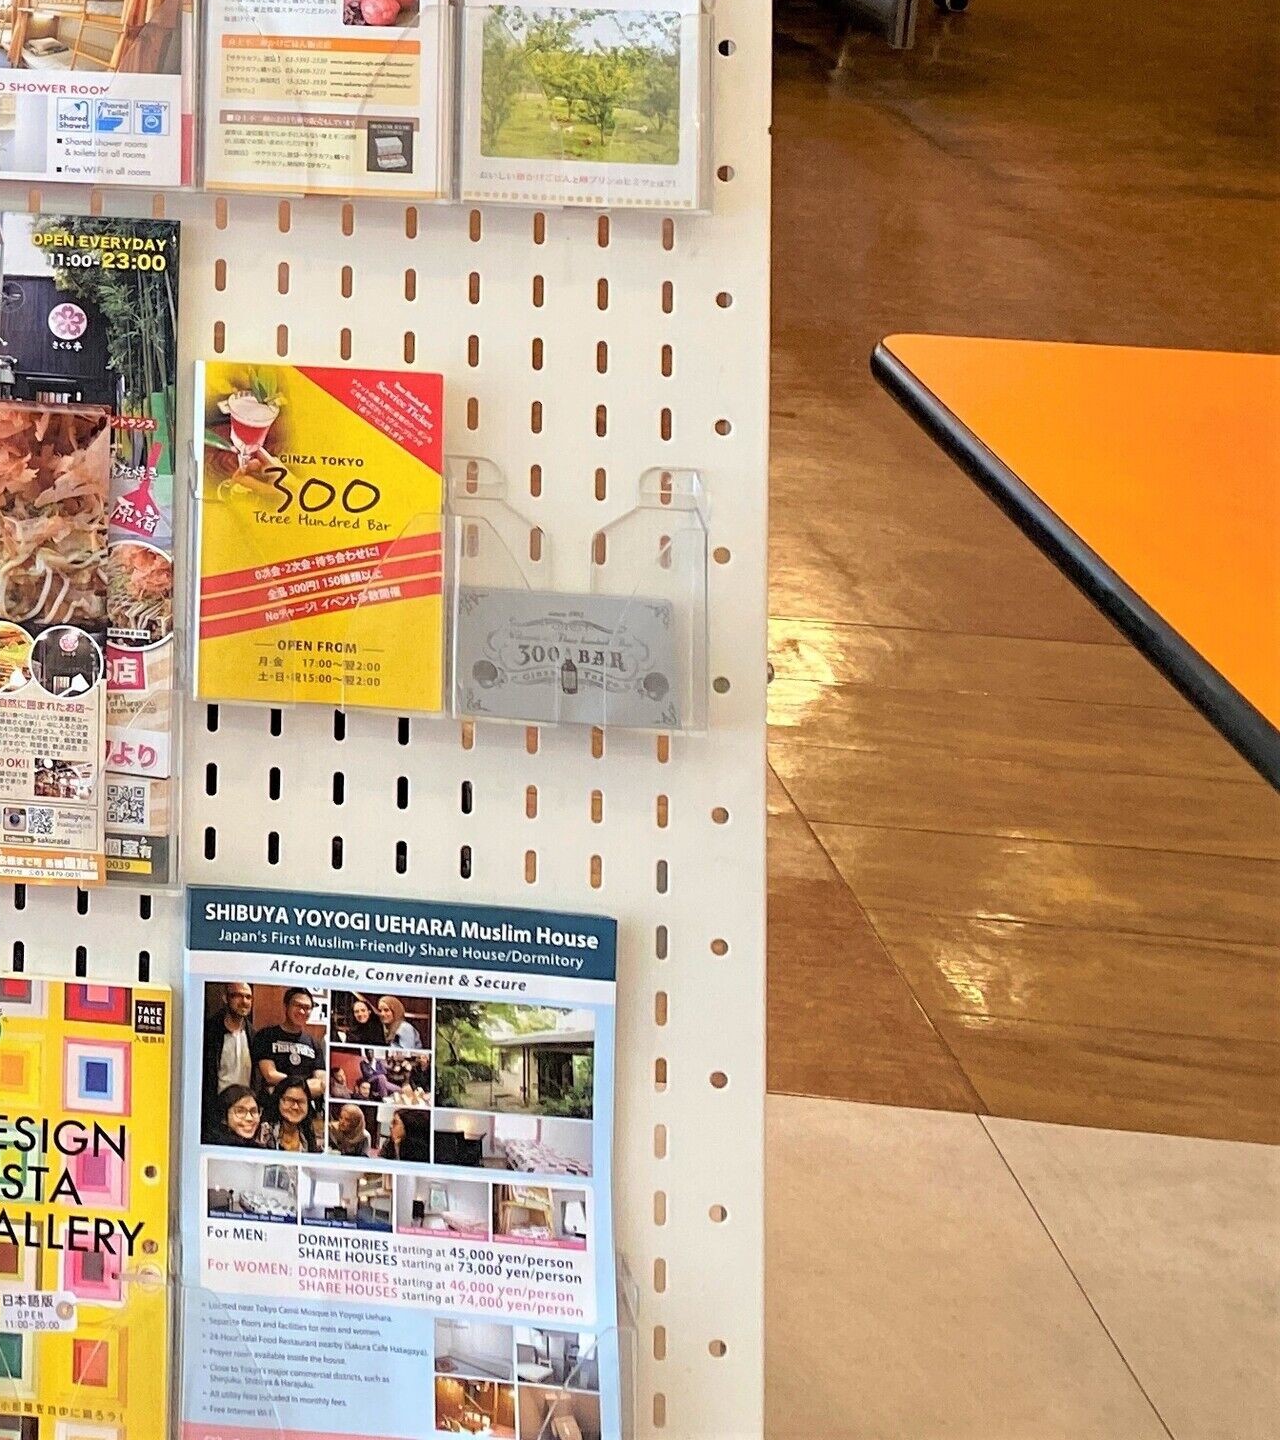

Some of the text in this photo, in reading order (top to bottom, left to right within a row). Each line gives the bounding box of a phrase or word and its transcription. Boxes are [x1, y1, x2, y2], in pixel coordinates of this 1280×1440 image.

[33, 233, 166, 252] OPEN EVERYDAY
[280, 455, 364, 467] GINZA TOKYO
[264, 467, 380, 513] 300
[254, 511, 391, 531] Three Hundred Bar
[277, 640, 356, 653] OPEN FROM
[205, 902, 599, 950] SHIBUYA YOYOGI UEHARA Muslim House
[219, 929, 584, 970] Japan's First Muslim-Friendly Share House/Dormitory
[269, 959, 527, 992] Affordable, Convenient & Secure
[138, 1006, 162, 1015] TAKE
[138, 1015, 162, 1025] FREE
[1, 1294, 55, 1308] 日本語版
